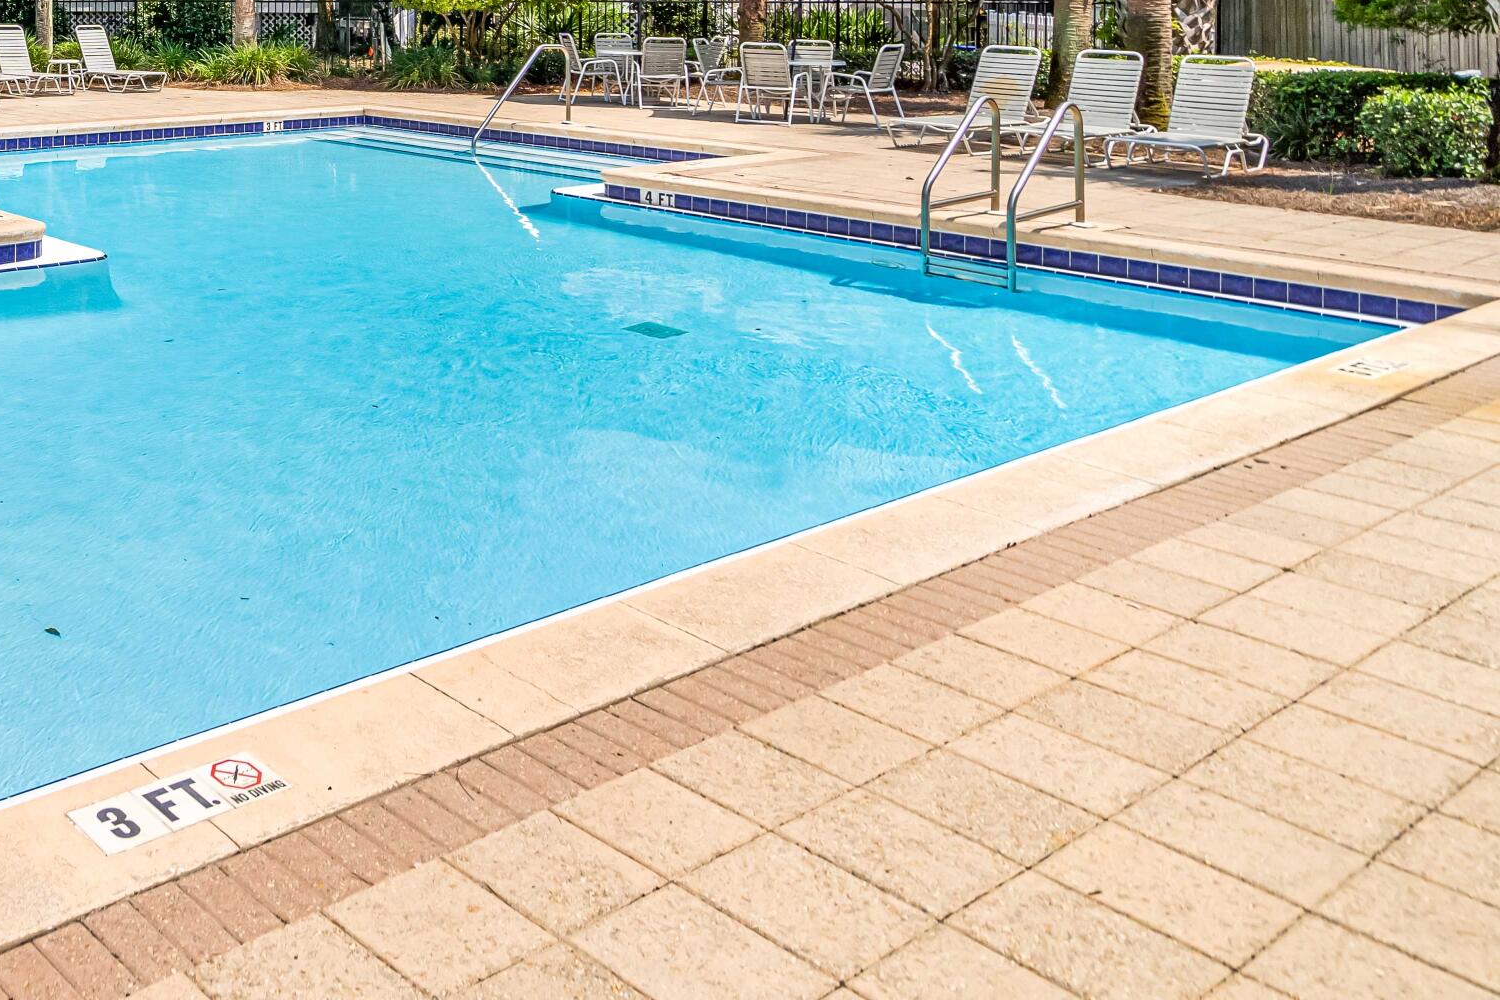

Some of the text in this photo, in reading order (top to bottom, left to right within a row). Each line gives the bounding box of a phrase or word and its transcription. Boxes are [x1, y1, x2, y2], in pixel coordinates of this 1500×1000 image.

[266, 122, 271, 131] 3
[645, 191, 653, 204] 4
[230, 779, 288, 805] NO DIVING
[96, 777, 222, 839] 3 FT.
